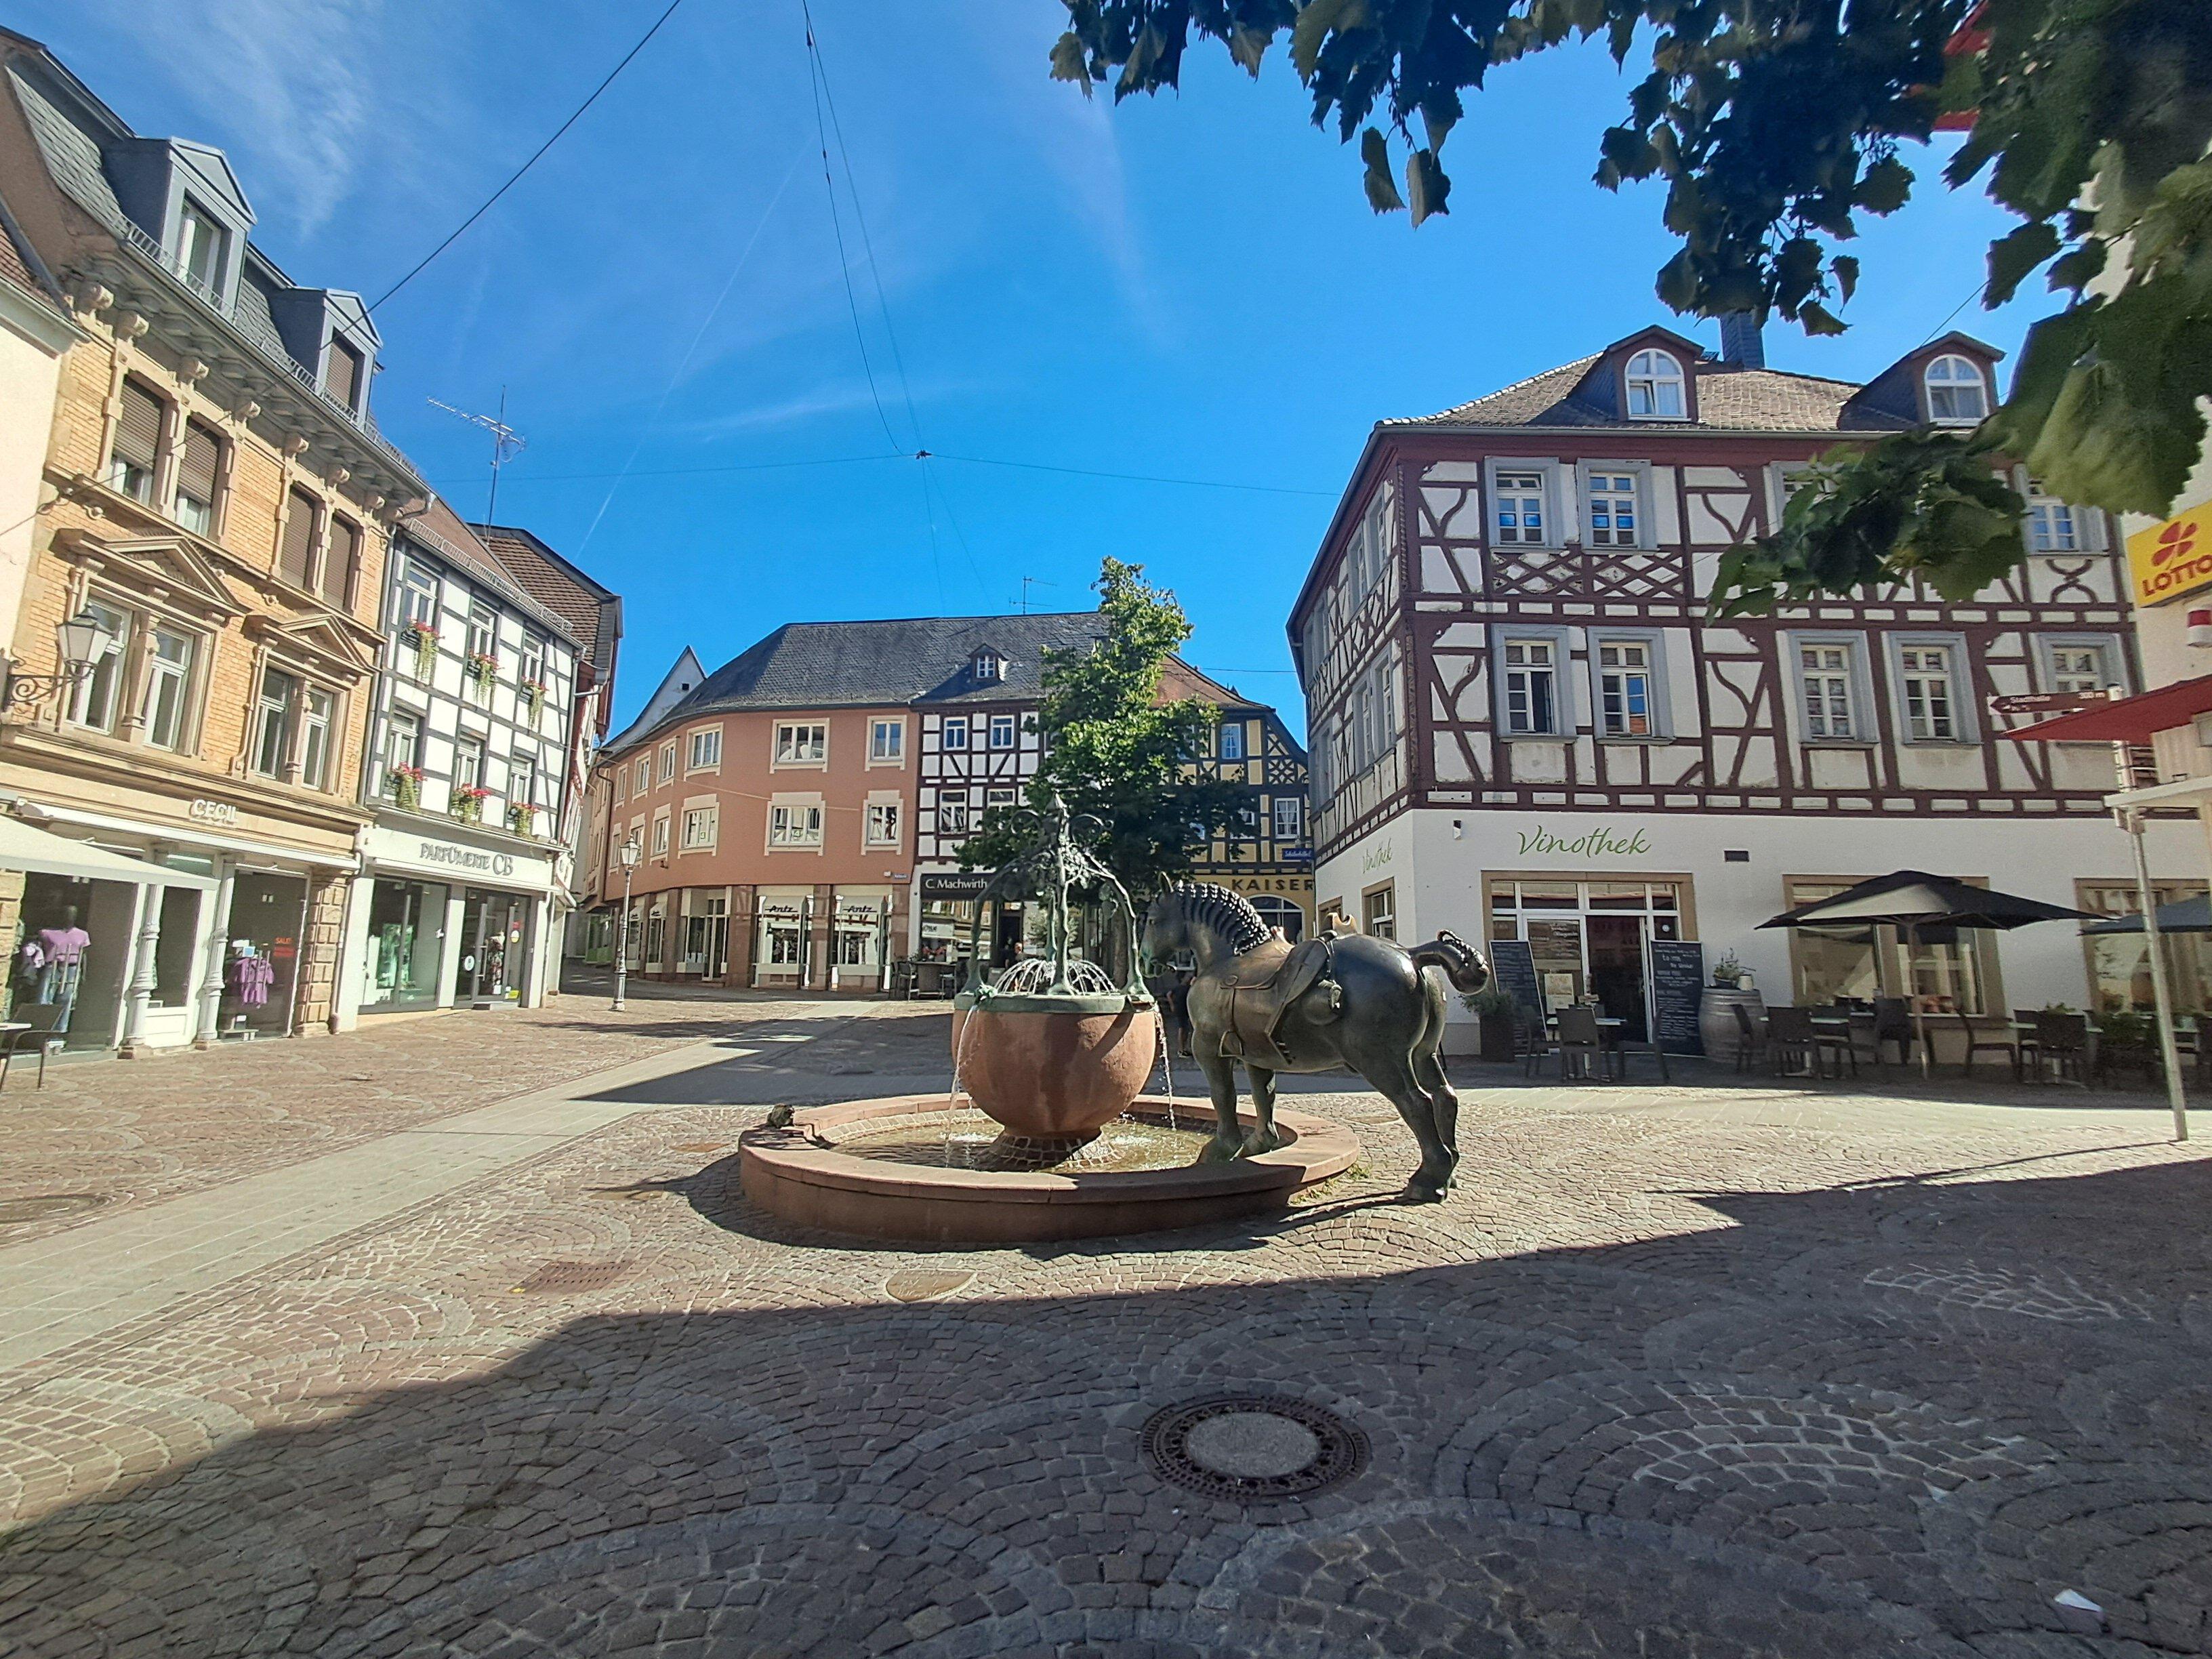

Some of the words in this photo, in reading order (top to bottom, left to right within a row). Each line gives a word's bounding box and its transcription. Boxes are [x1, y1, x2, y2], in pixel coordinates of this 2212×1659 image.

[2142, 554, 2212, 596] LOTTO
[194, 799, 237, 823] CECIL
[1362, 837, 1393, 874] Vinothek
[1517, 825, 1652, 858] Vinothek
[419, 842, 490, 869] PARFÜMERIE
[493, 853, 513, 876] CB
[937, 878, 987, 889] Machwirth
[1231, 879, 1313, 890] KAISER
